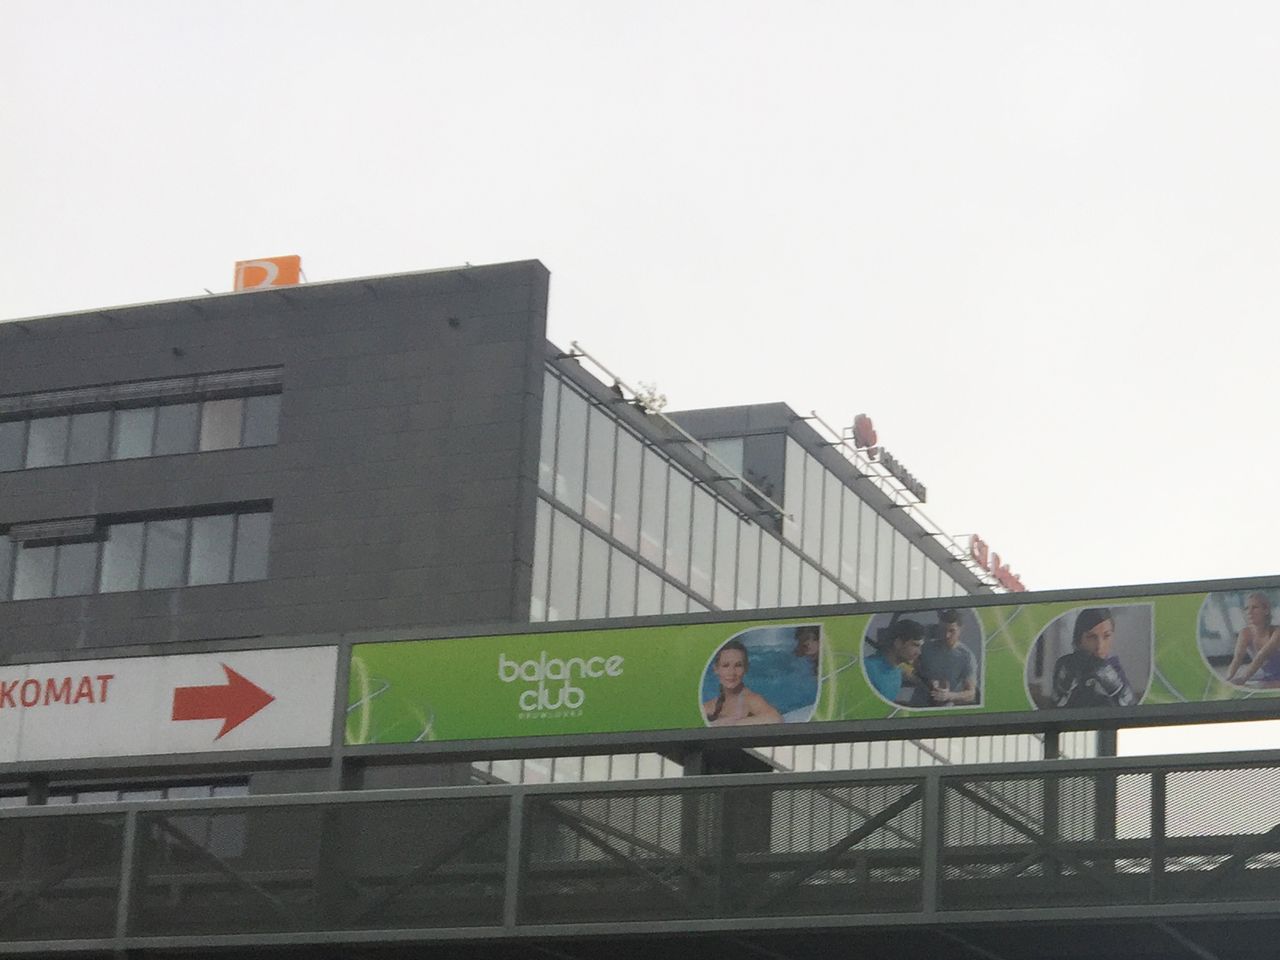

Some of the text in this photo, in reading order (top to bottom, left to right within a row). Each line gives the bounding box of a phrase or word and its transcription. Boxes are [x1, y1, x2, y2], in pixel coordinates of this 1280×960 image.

[498, 650, 625, 682] balance
[0, 674, 115, 709] KOMAT
[519, 679, 585, 711] club
